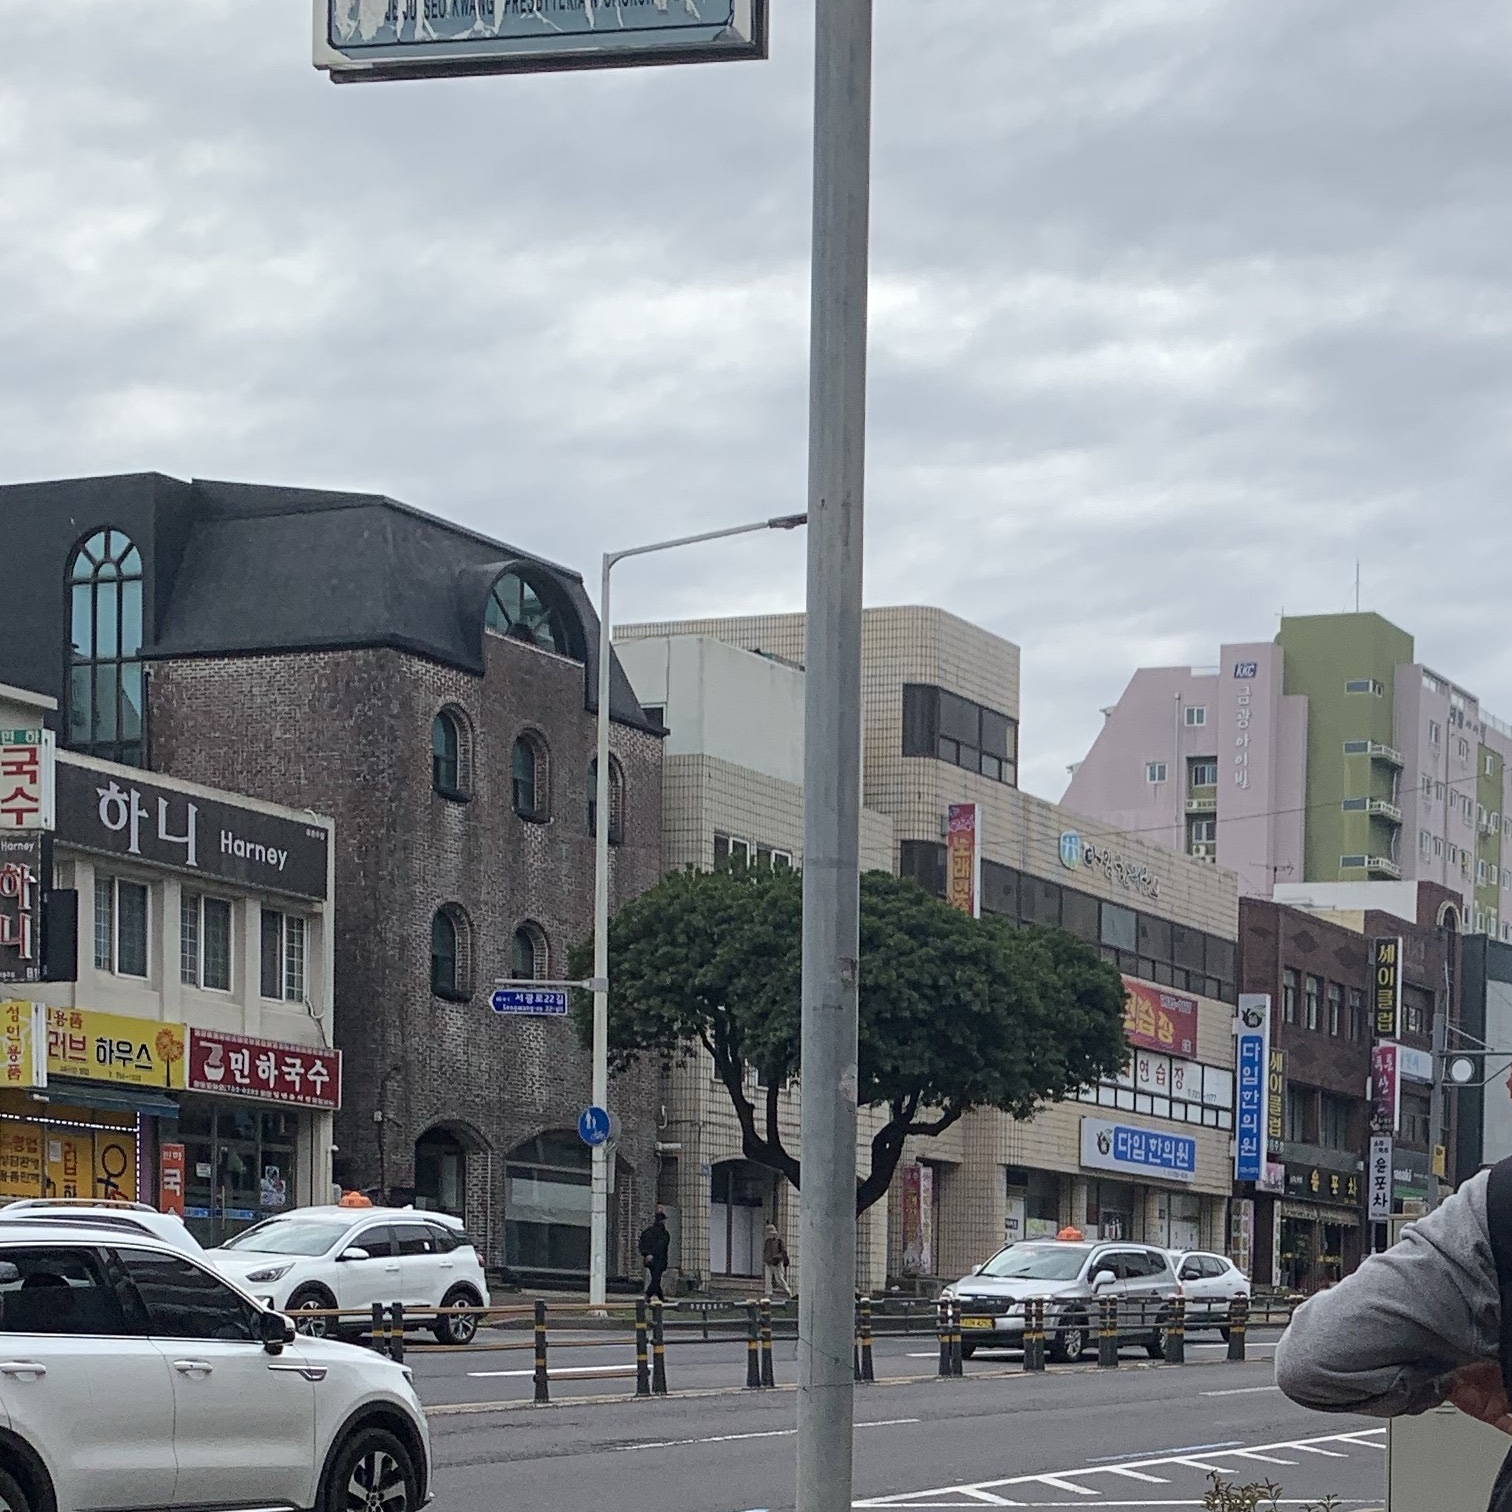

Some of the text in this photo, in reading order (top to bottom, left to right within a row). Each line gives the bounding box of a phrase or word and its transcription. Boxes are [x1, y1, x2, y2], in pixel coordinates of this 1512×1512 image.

[0, 747, 39, 826] 국수
[96, 780, 288, 872] 하니 Harney
[1, 840, 34, 853] Harney
[0, 862, 37, 959] 하니
[1378, 944, 1395, 1032] 세이클럽
[48, 1031, 153, 1072] 러브 하우스
[228, 1048, 330, 1096] 민하국수
[1241, 1042, 1261, 1158] 다임한의원
[1117, 1132, 1189, 1168] 다임한의원
